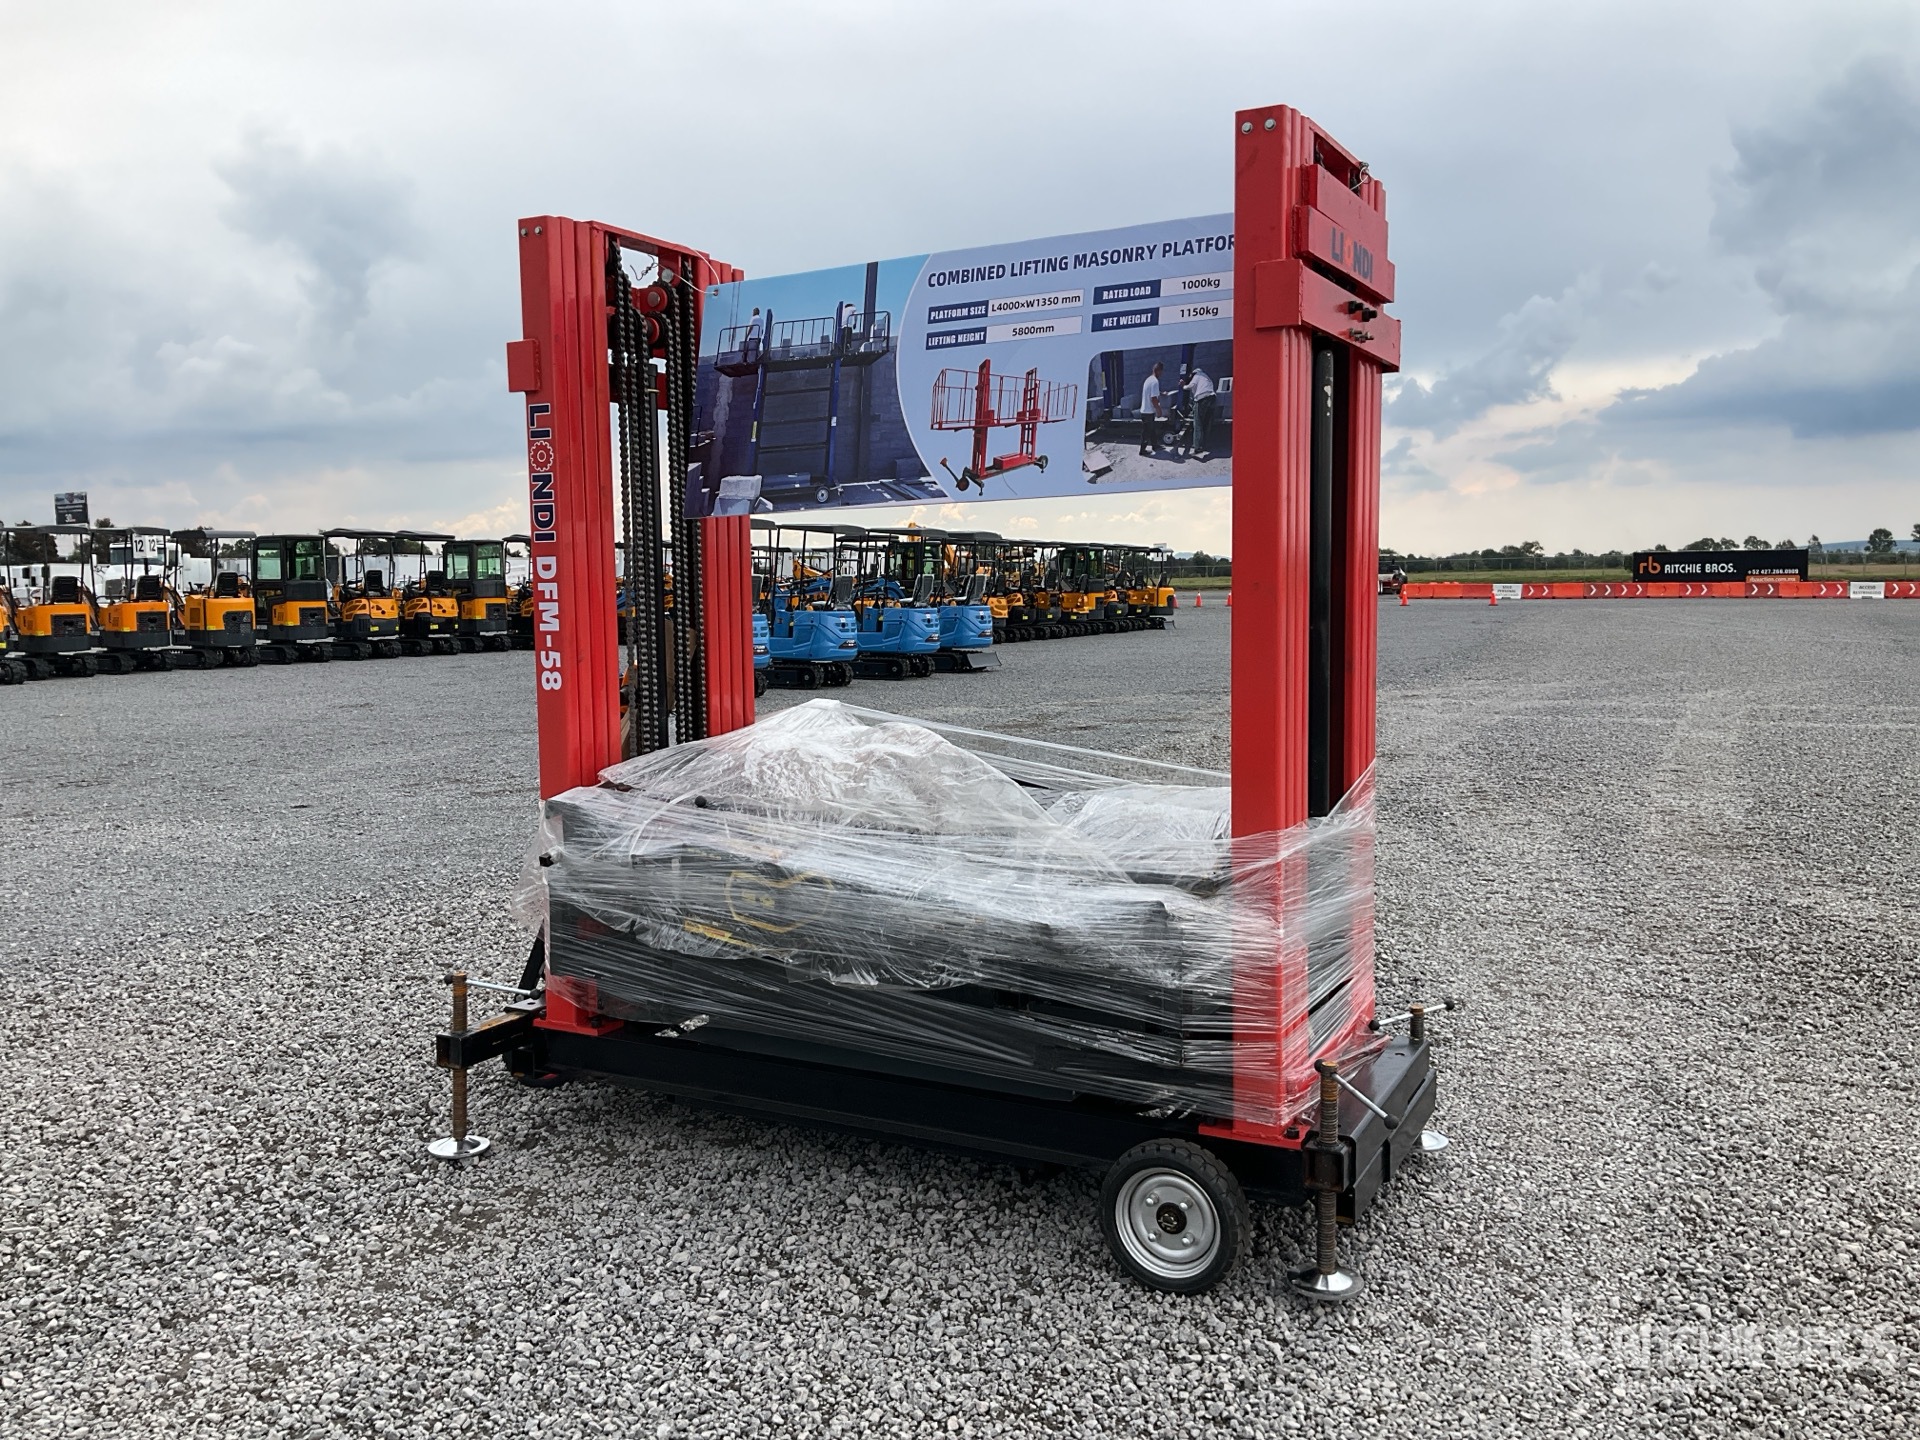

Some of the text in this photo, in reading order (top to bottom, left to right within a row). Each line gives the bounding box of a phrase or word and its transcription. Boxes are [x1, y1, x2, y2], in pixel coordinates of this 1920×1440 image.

[928, 234, 1235, 288] COMBINED LIFTING MASONRY PLATFOR
[1331, 227, 1373, 283] LIONDI
[1182, 277, 1221, 290] 1000kg
[1061, 295, 1081, 304] mm
[1102, 286, 1151, 300] RATED LOAD
[930, 305, 986, 321] PLATFORM SIZE
[1180, 306, 1219, 318] 1150kg
[1102, 313, 1152, 328] NET WEIGHT
[1012, 325, 1055, 337] 5800mm
[928, 331, 985, 347] LIFTING HEIGHT
[133, 539, 145, 553] 12
[148, 539, 156, 552] 12
[529, 403, 563, 692] LIONDI DFM-58
[1639, 555, 1661, 575] rb
[1664, 563, 1737, 574] RITCHIE BROS.
